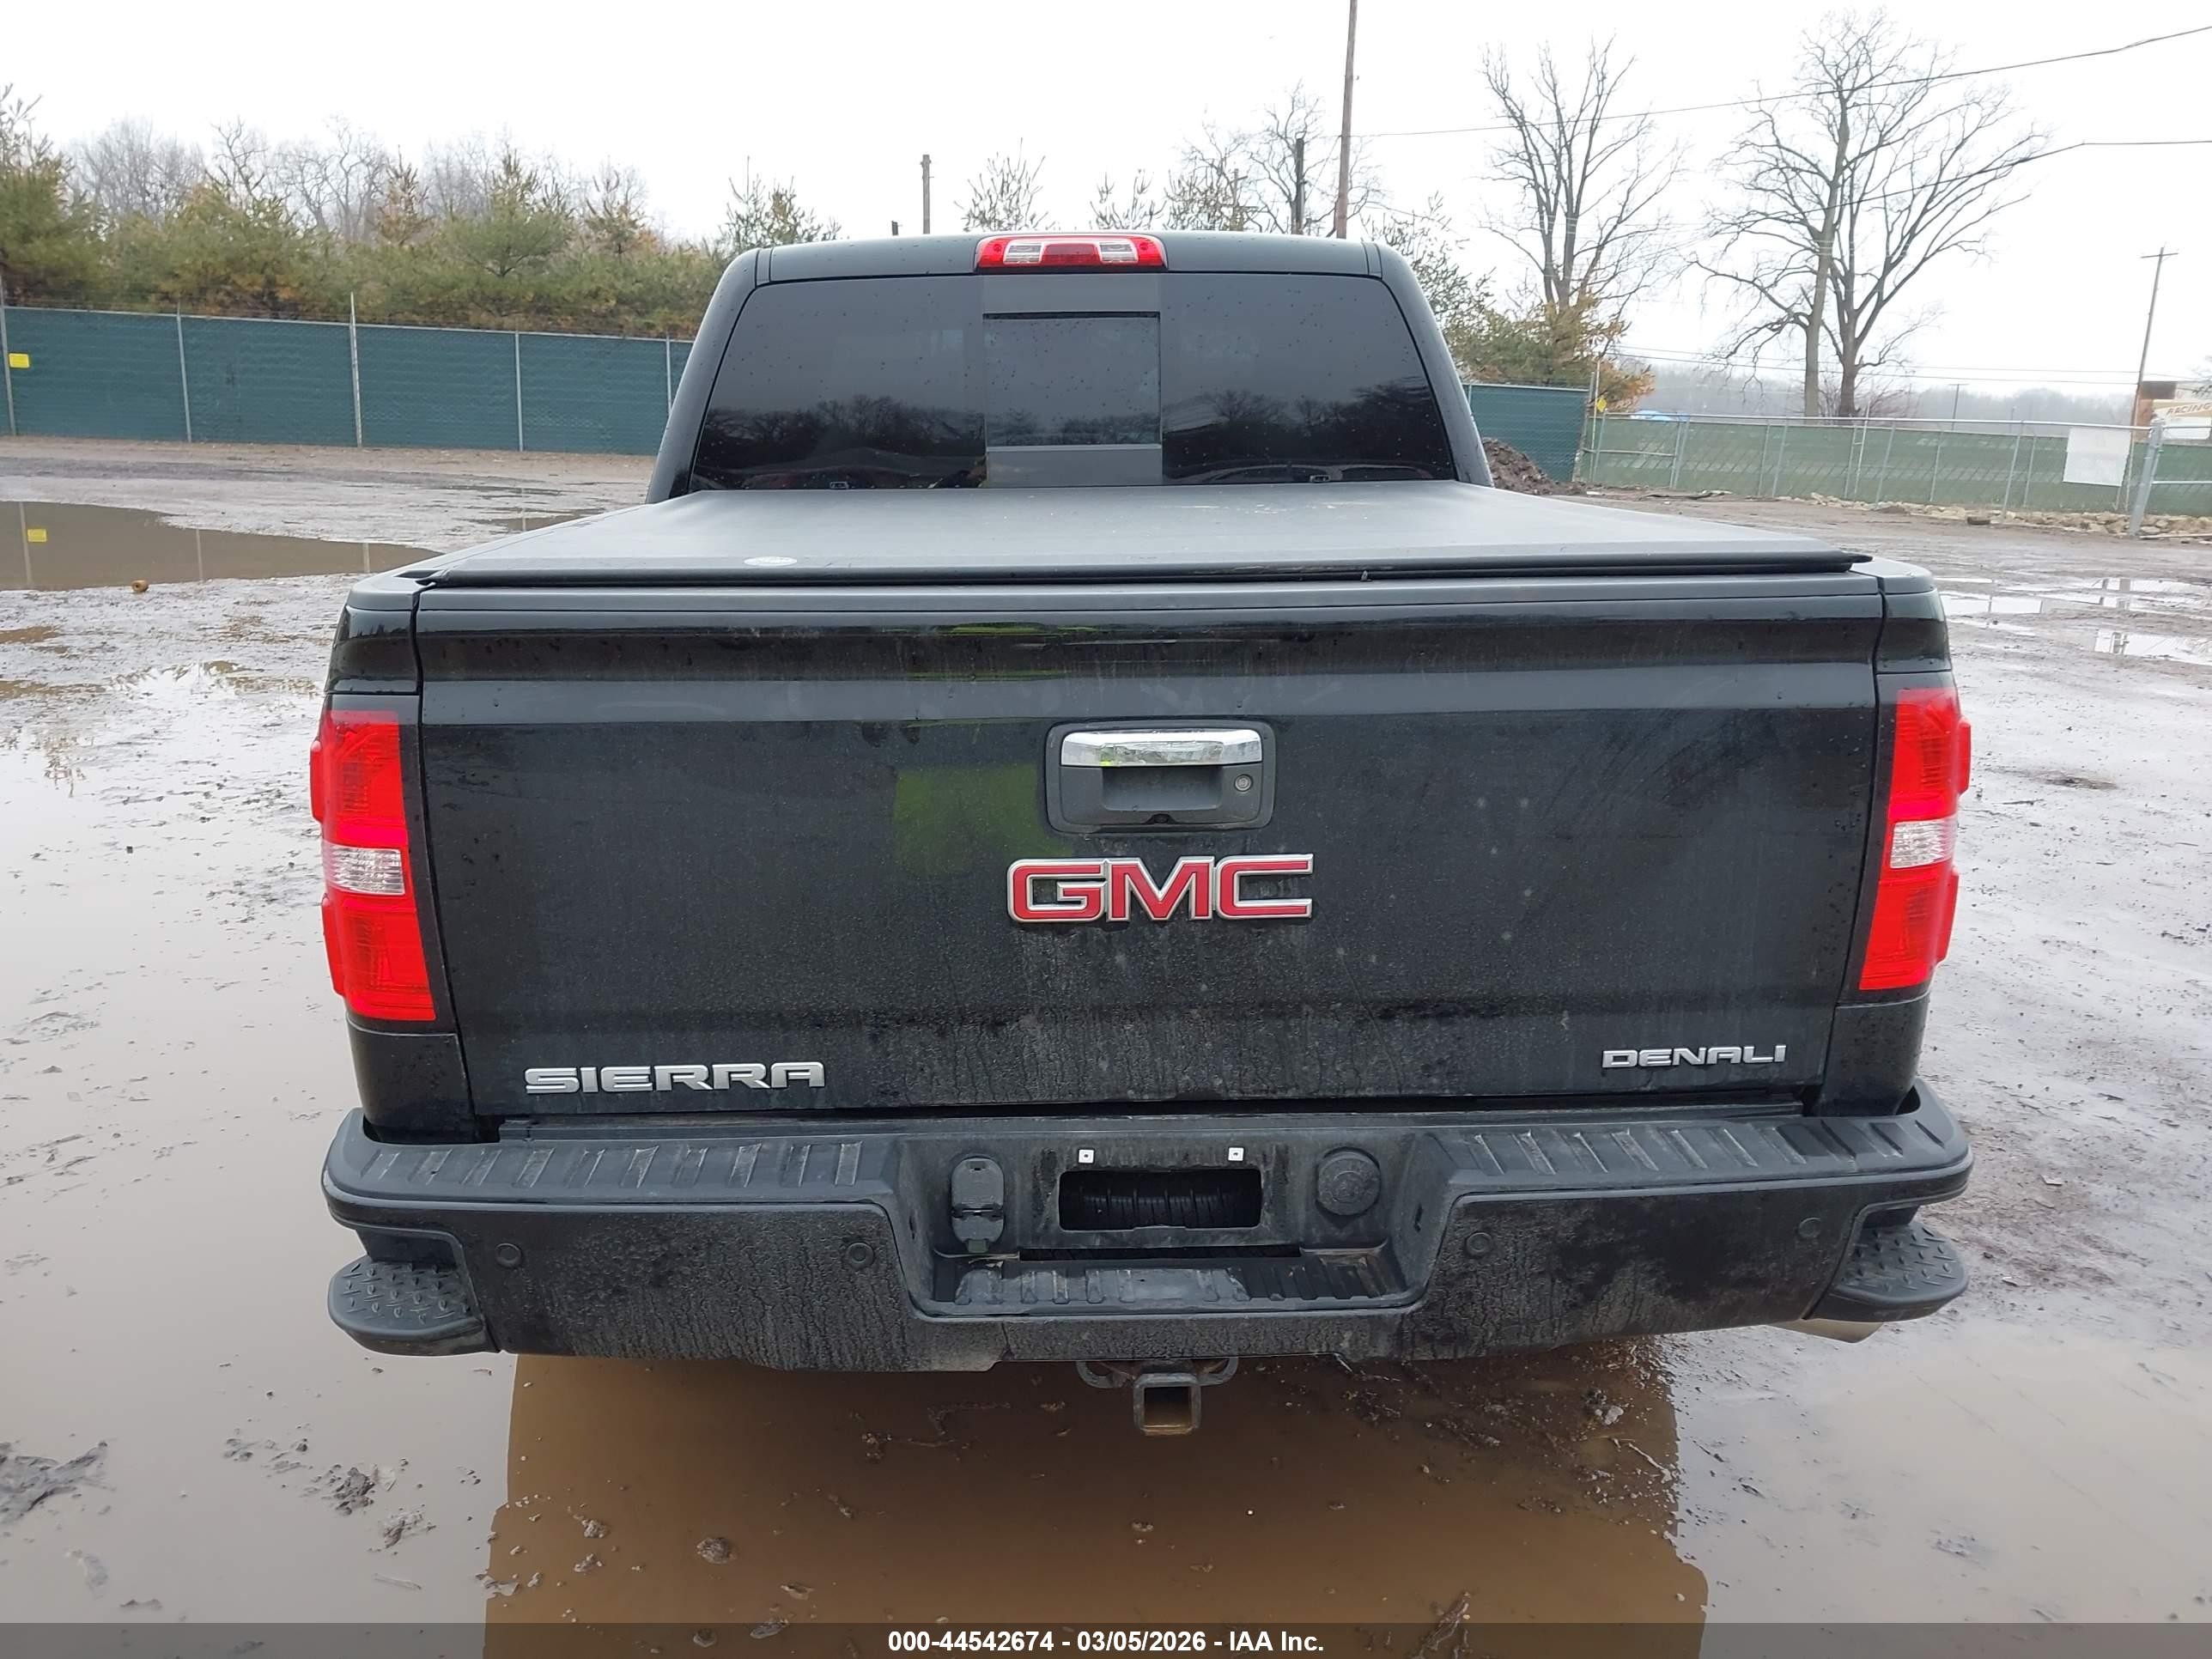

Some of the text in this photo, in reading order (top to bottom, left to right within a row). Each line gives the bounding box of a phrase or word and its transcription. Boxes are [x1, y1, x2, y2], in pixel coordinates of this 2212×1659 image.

[1006, 853, 1315, 924] GMC
[1602, 1044, 1787, 1068] DENALI
[525, 1061, 825, 1094] SIERRA
